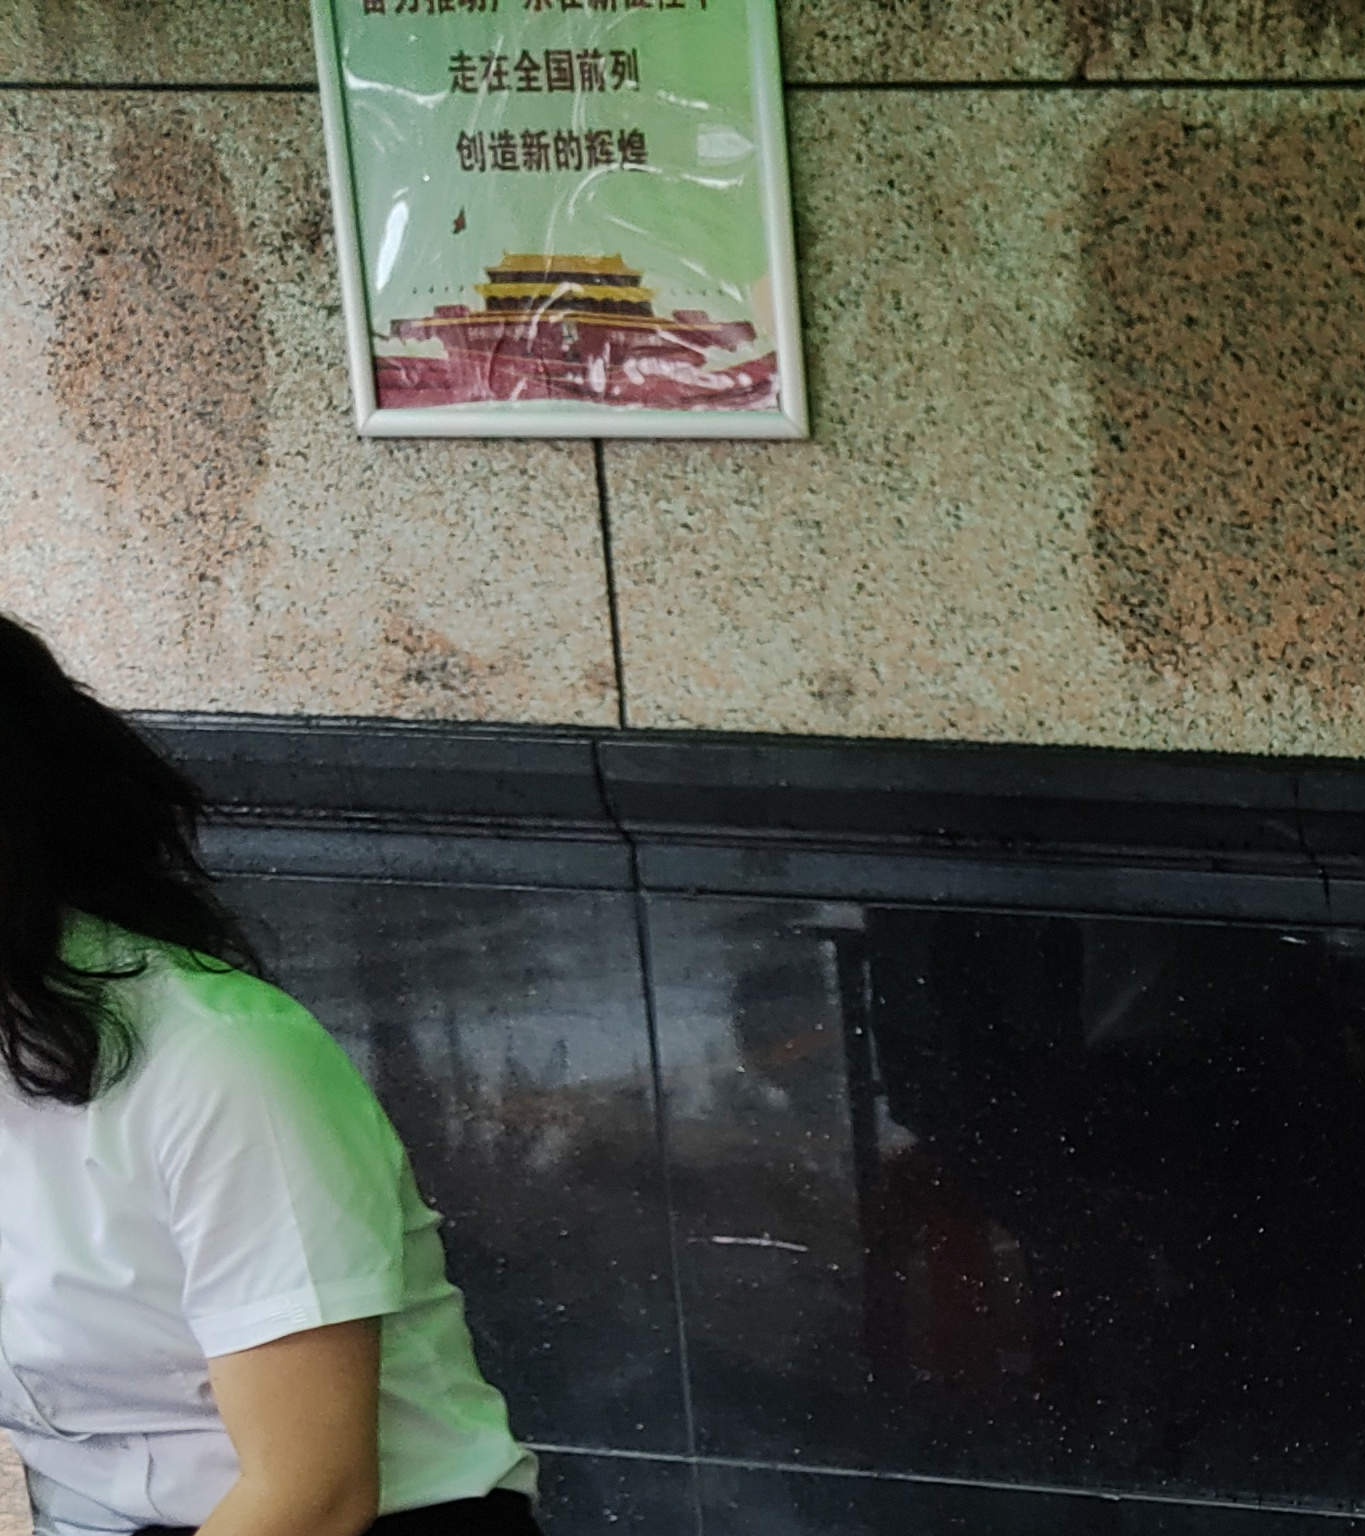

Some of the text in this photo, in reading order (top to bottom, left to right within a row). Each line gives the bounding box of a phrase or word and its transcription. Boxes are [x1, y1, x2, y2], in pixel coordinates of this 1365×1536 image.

[448, 48, 641, 94] 走在全国前列
[456, 128, 650, 173] 创造新的辉煌
